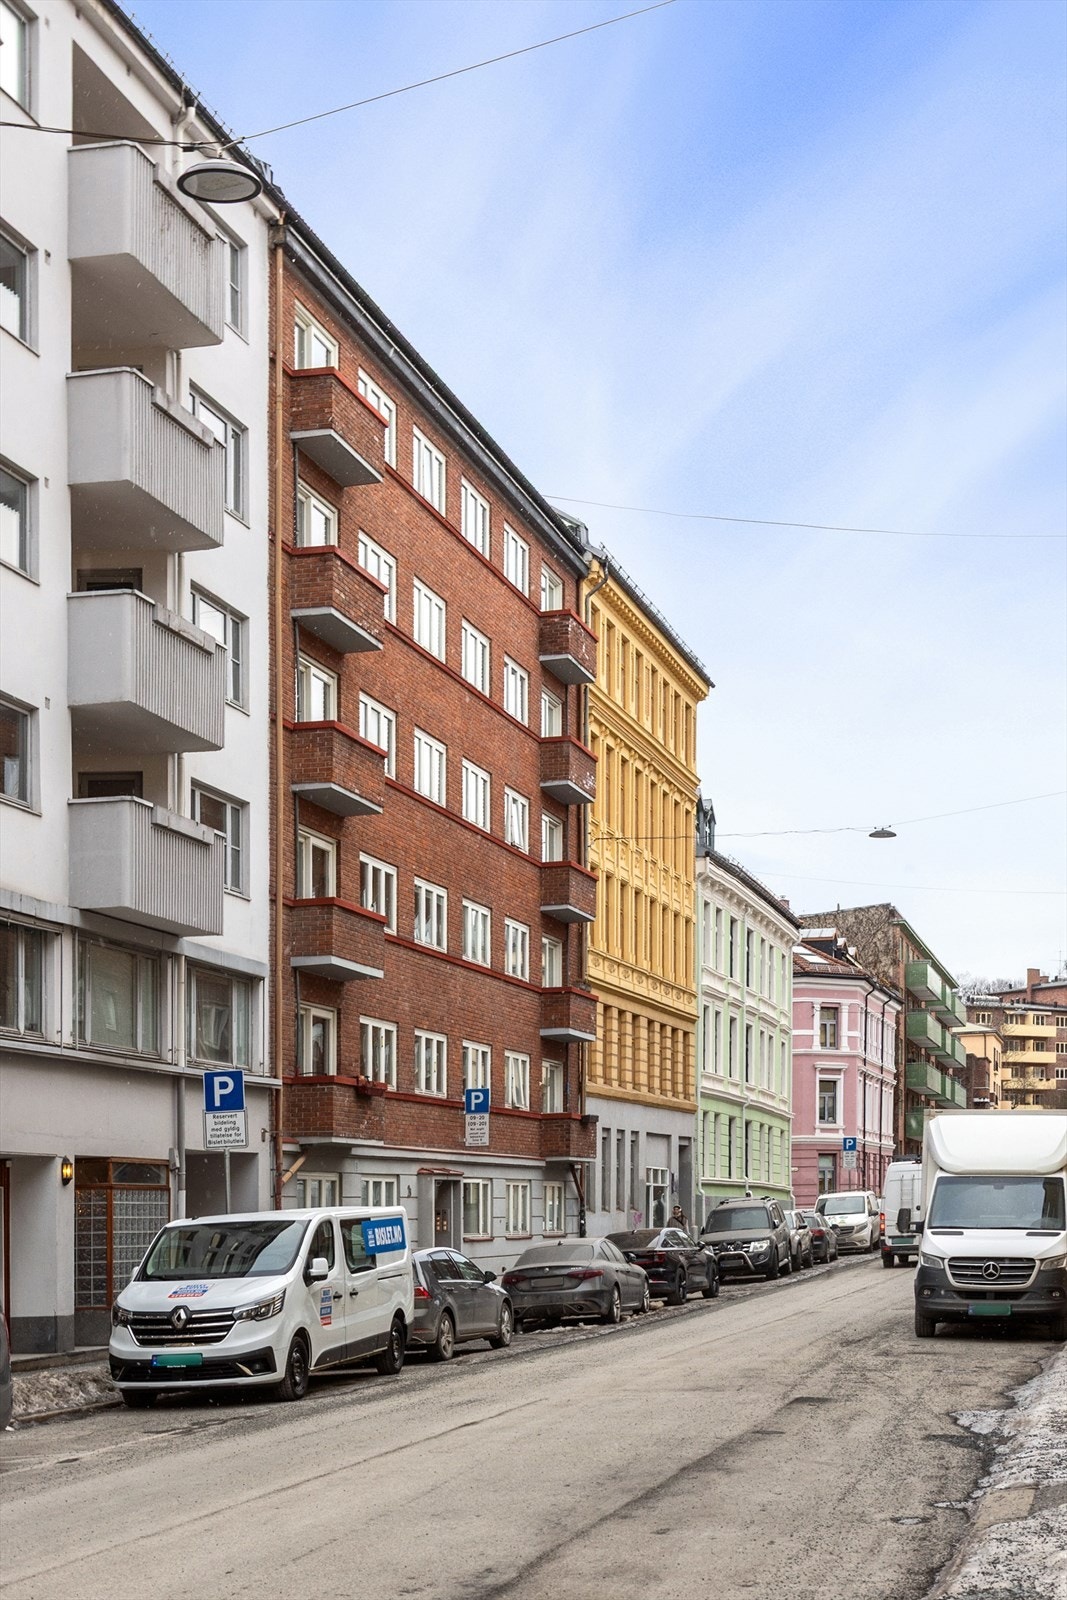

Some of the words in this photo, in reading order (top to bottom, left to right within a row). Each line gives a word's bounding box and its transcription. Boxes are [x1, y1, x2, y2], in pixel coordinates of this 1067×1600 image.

[213, 1076, 234, 1107] P
[471, 1091, 484, 1111] P
[846, 1138, 854, 1150] P
[374, 1224, 402, 1246] BISLET.NO
